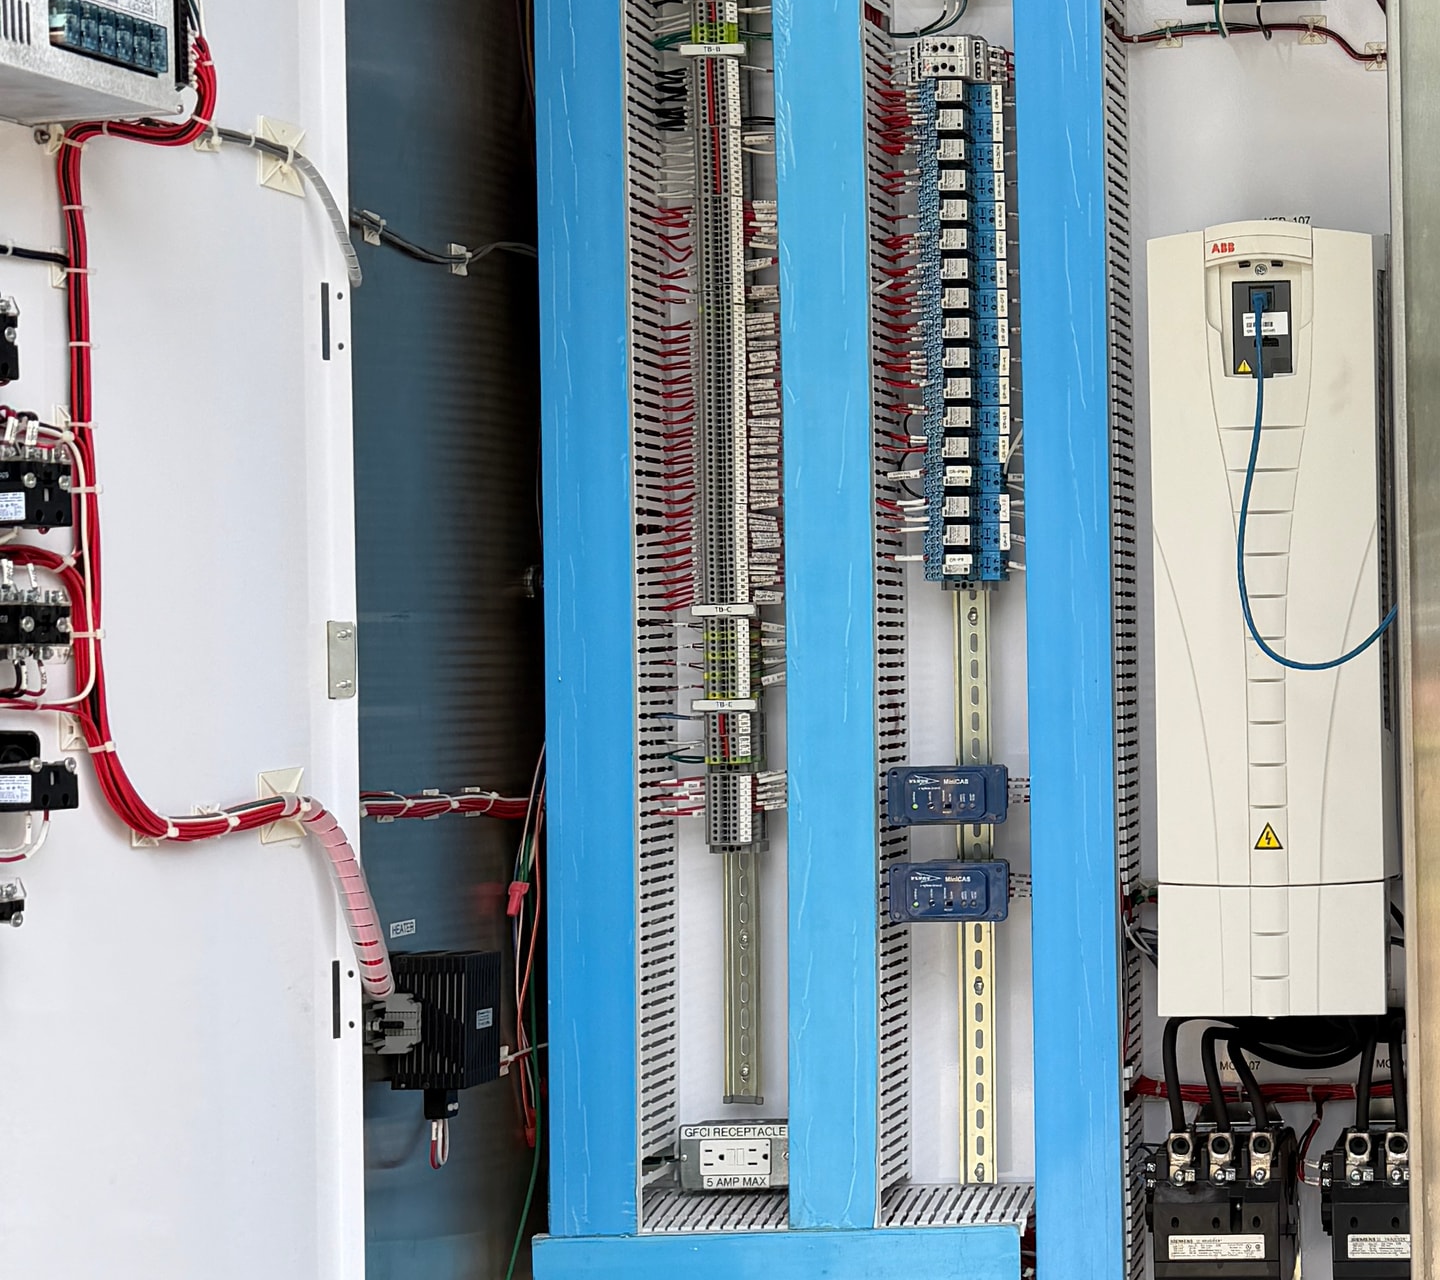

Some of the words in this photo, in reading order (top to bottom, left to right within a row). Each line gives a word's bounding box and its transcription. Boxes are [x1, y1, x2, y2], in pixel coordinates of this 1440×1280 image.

[1211, 242, 1235, 254] ABB
[391, 920, 414, 935] HEATER
[684, 1127, 710, 1137] GFCI
[713, 1126, 787, 1137] RECEPTACLE
[706, 1177, 713, 1187] 5
[716, 1177, 740, 1187] AMP
[742, 1177, 767, 1186] MAX
